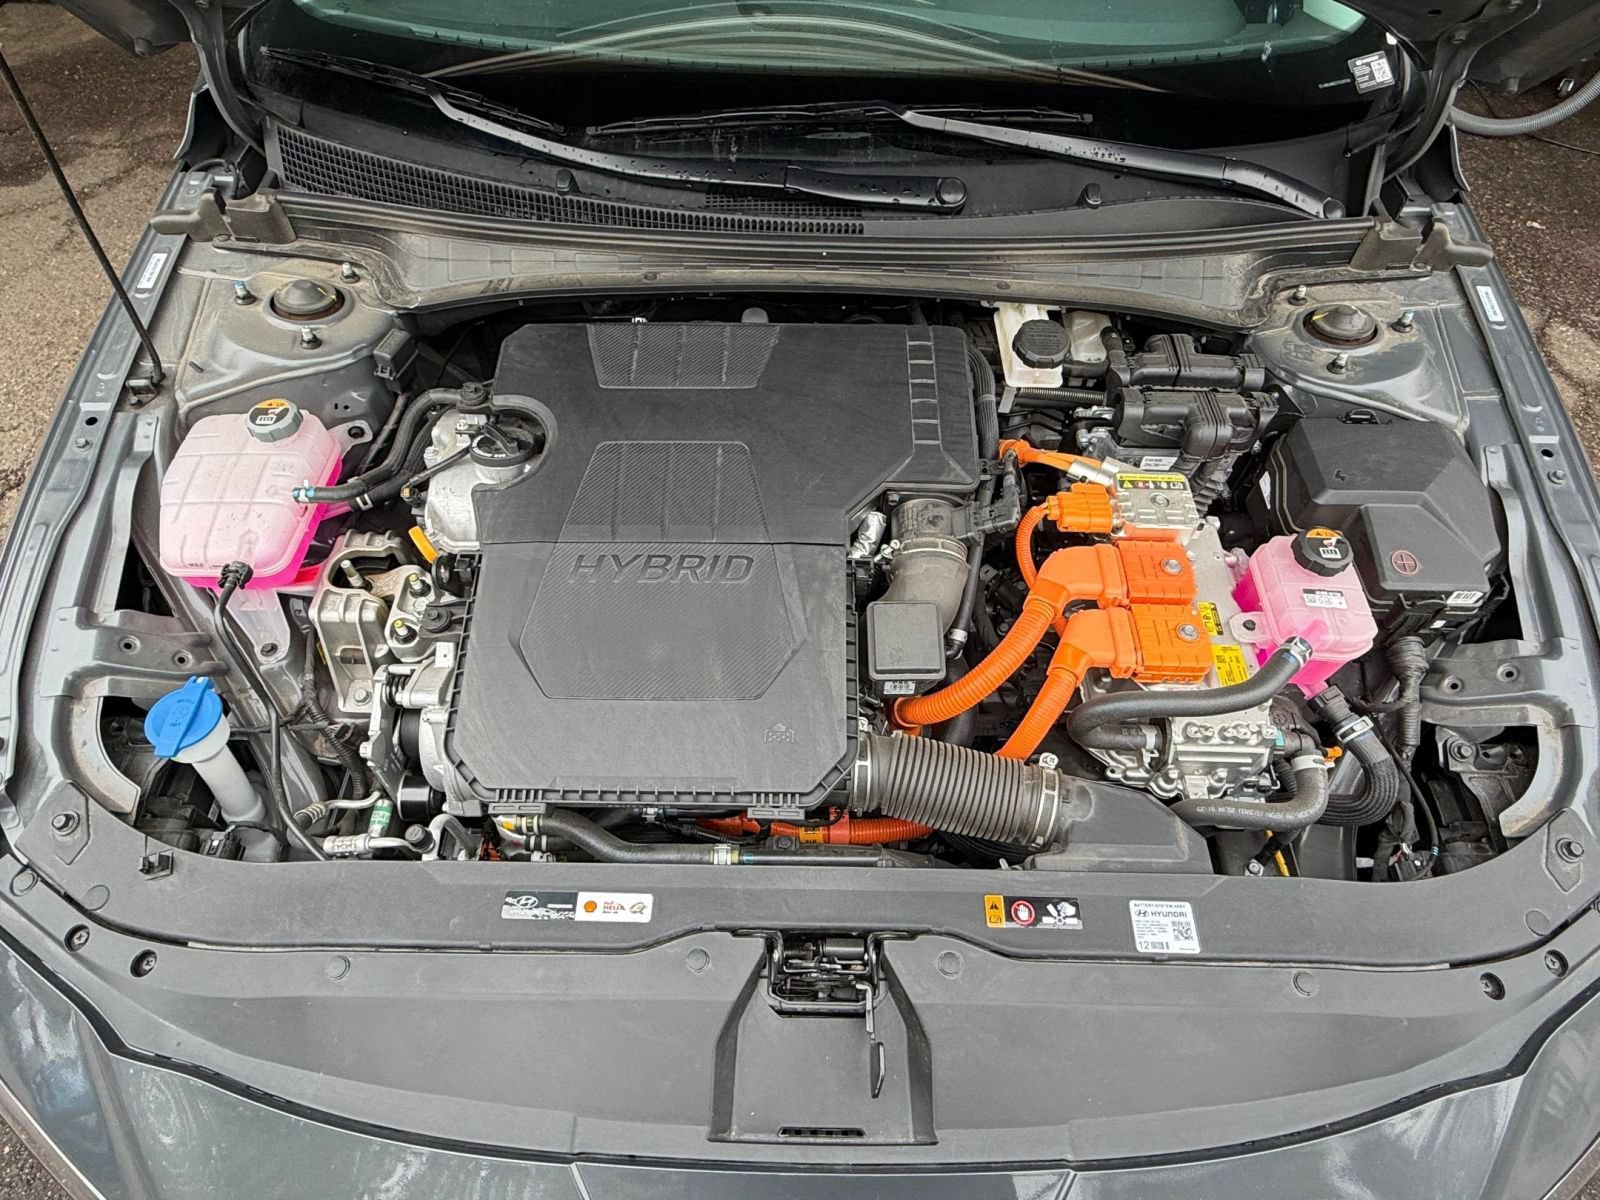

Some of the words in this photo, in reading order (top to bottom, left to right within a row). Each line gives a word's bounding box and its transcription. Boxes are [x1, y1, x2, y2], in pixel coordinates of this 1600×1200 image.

[567, 554, 755, 584] HYBRID
[603, 903, 626, 911] HELIX
[1138, 941, 1150, 950] 12
